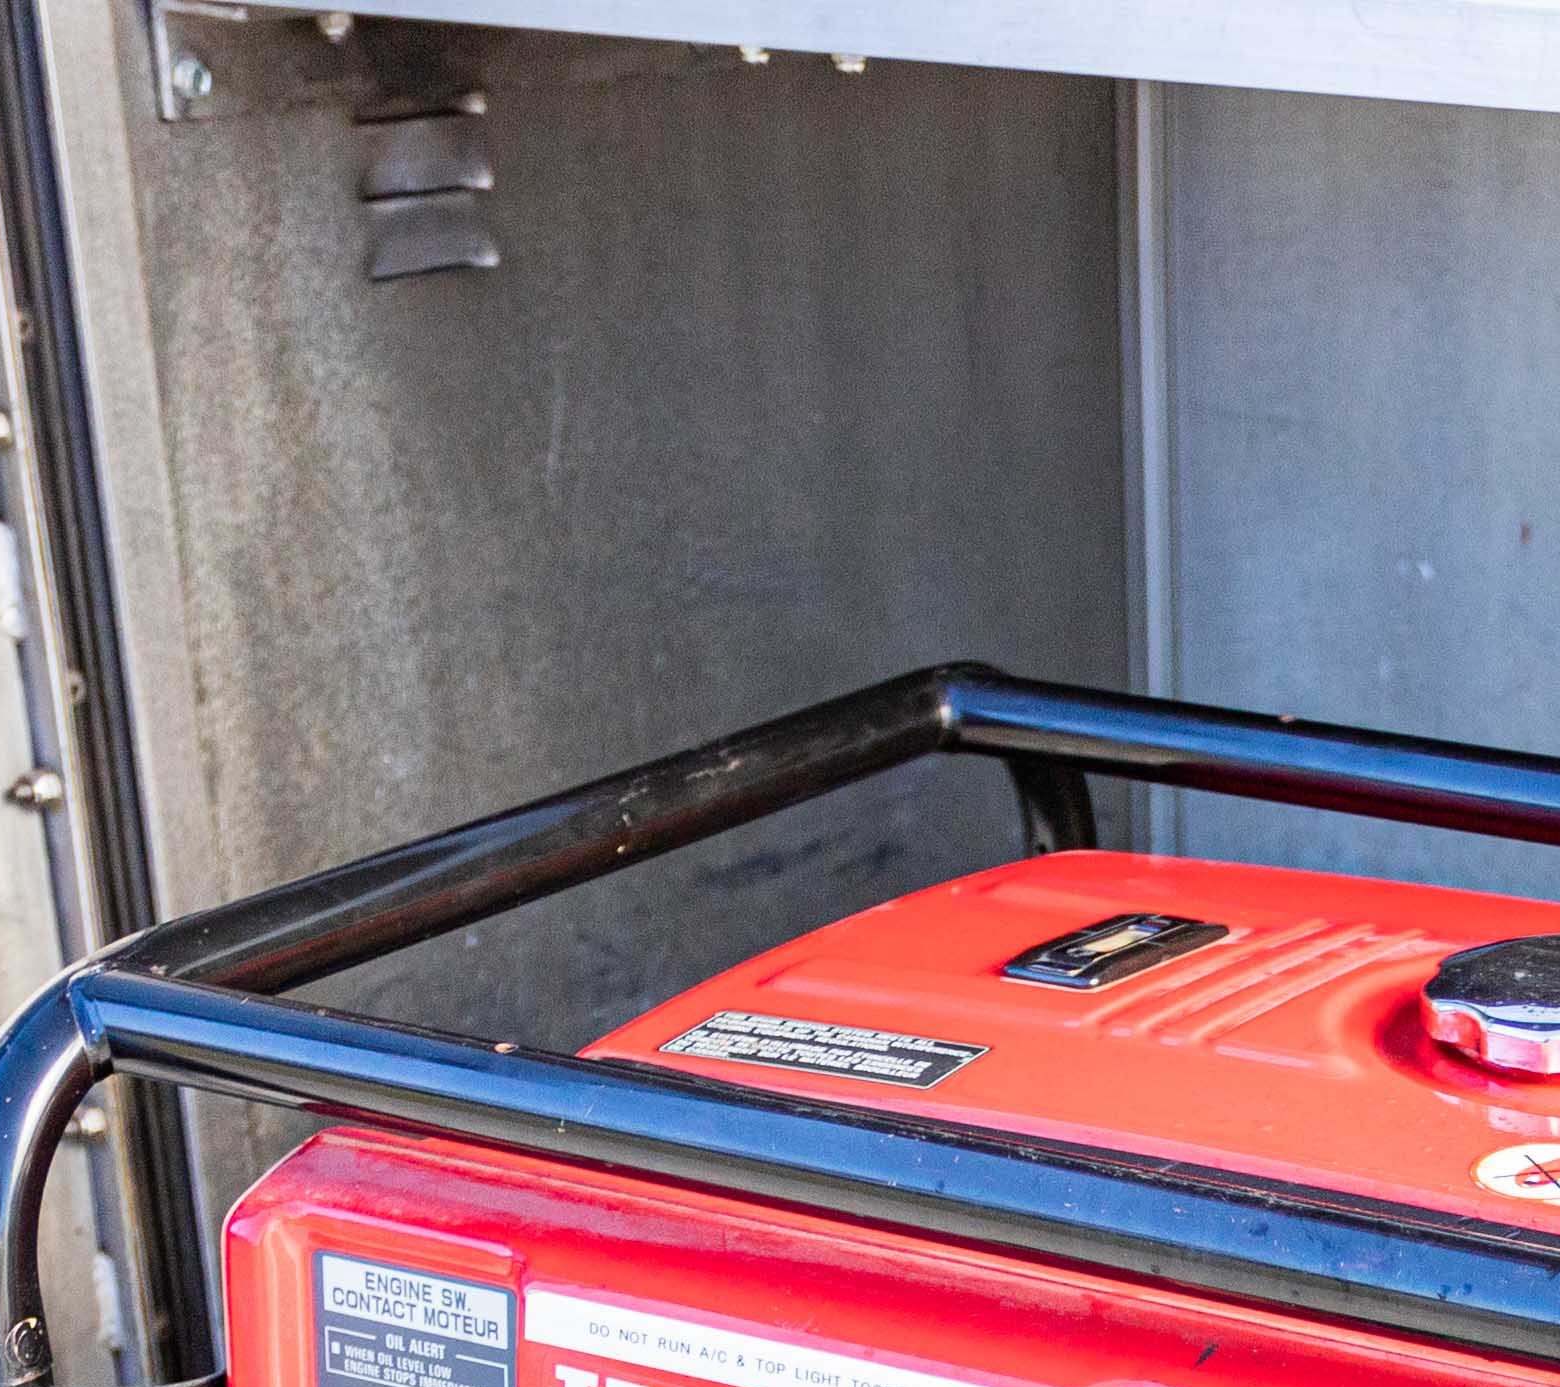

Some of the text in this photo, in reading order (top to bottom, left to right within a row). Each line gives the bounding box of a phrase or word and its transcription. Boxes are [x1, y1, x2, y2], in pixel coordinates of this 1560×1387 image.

[365, 1271, 473, 1313] ENGINE SW.
[332, 1286, 499, 1341] CONTACT MOTEUR
[344, 1344, 453, 1380] WHEN OIL LEVEL LOW
[385, 1333, 446, 1361] OIL ALERT
[589, 1321, 610, 1338] DO
[619, 1328, 648, 1346] NOT
[658, 1336, 691, 1356] RUN
[699, 1346, 728, 1366] A/C
[736, 1354, 746, 1369] &
[756, 1357, 787, 1377] TOP
[344, 1359, 380, 1378] ENGINE
[383, 1368, 416, 1387] STOPS
